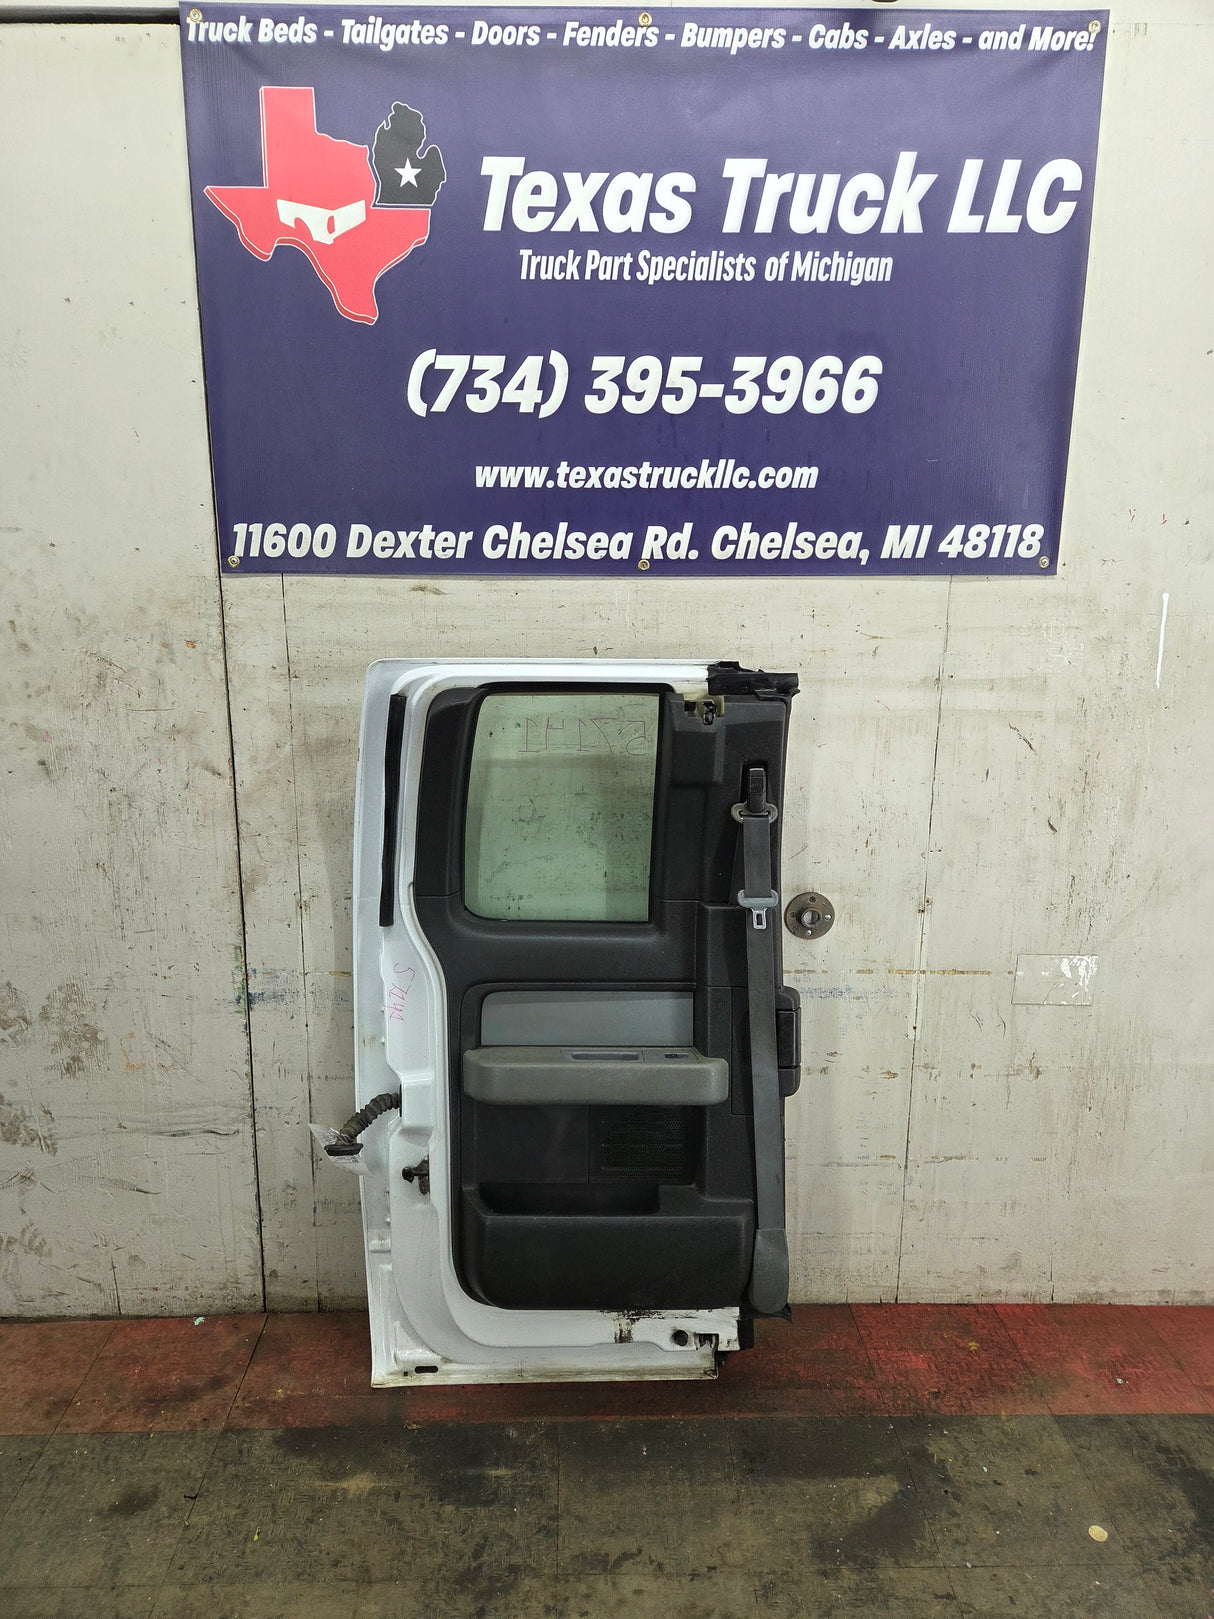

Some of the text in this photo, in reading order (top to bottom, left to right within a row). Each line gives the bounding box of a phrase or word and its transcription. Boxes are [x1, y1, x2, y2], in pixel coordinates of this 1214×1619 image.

[186, 16, 252, 44] Truck
[258, 16, 318, 44] Beds
[342, 16, 449, 51] Tailgates
[472, 20, 541, 46] Doors
[563, 20, 659, 48] Fenders
[681, 21, 787, 55] Bumpers
[808, 22, 869, 50] Cabs
[889, 23, 957, 50] Axles
[978, 23, 1027, 51] and
[1028, 26, 1099, 52] More!
[480, 150, 1084, 235] Texas Truck LLC
[519, 248, 894, 286] Truck Part Specialists of Michigan
[407, 348, 884, 419] (734) 395-3966
[475, 458, 819, 489] www.texastruckllc.com
[232, 521, 1044, 566] 11600 Dexter Chelsea Rd. Chelsea, MI 48118
